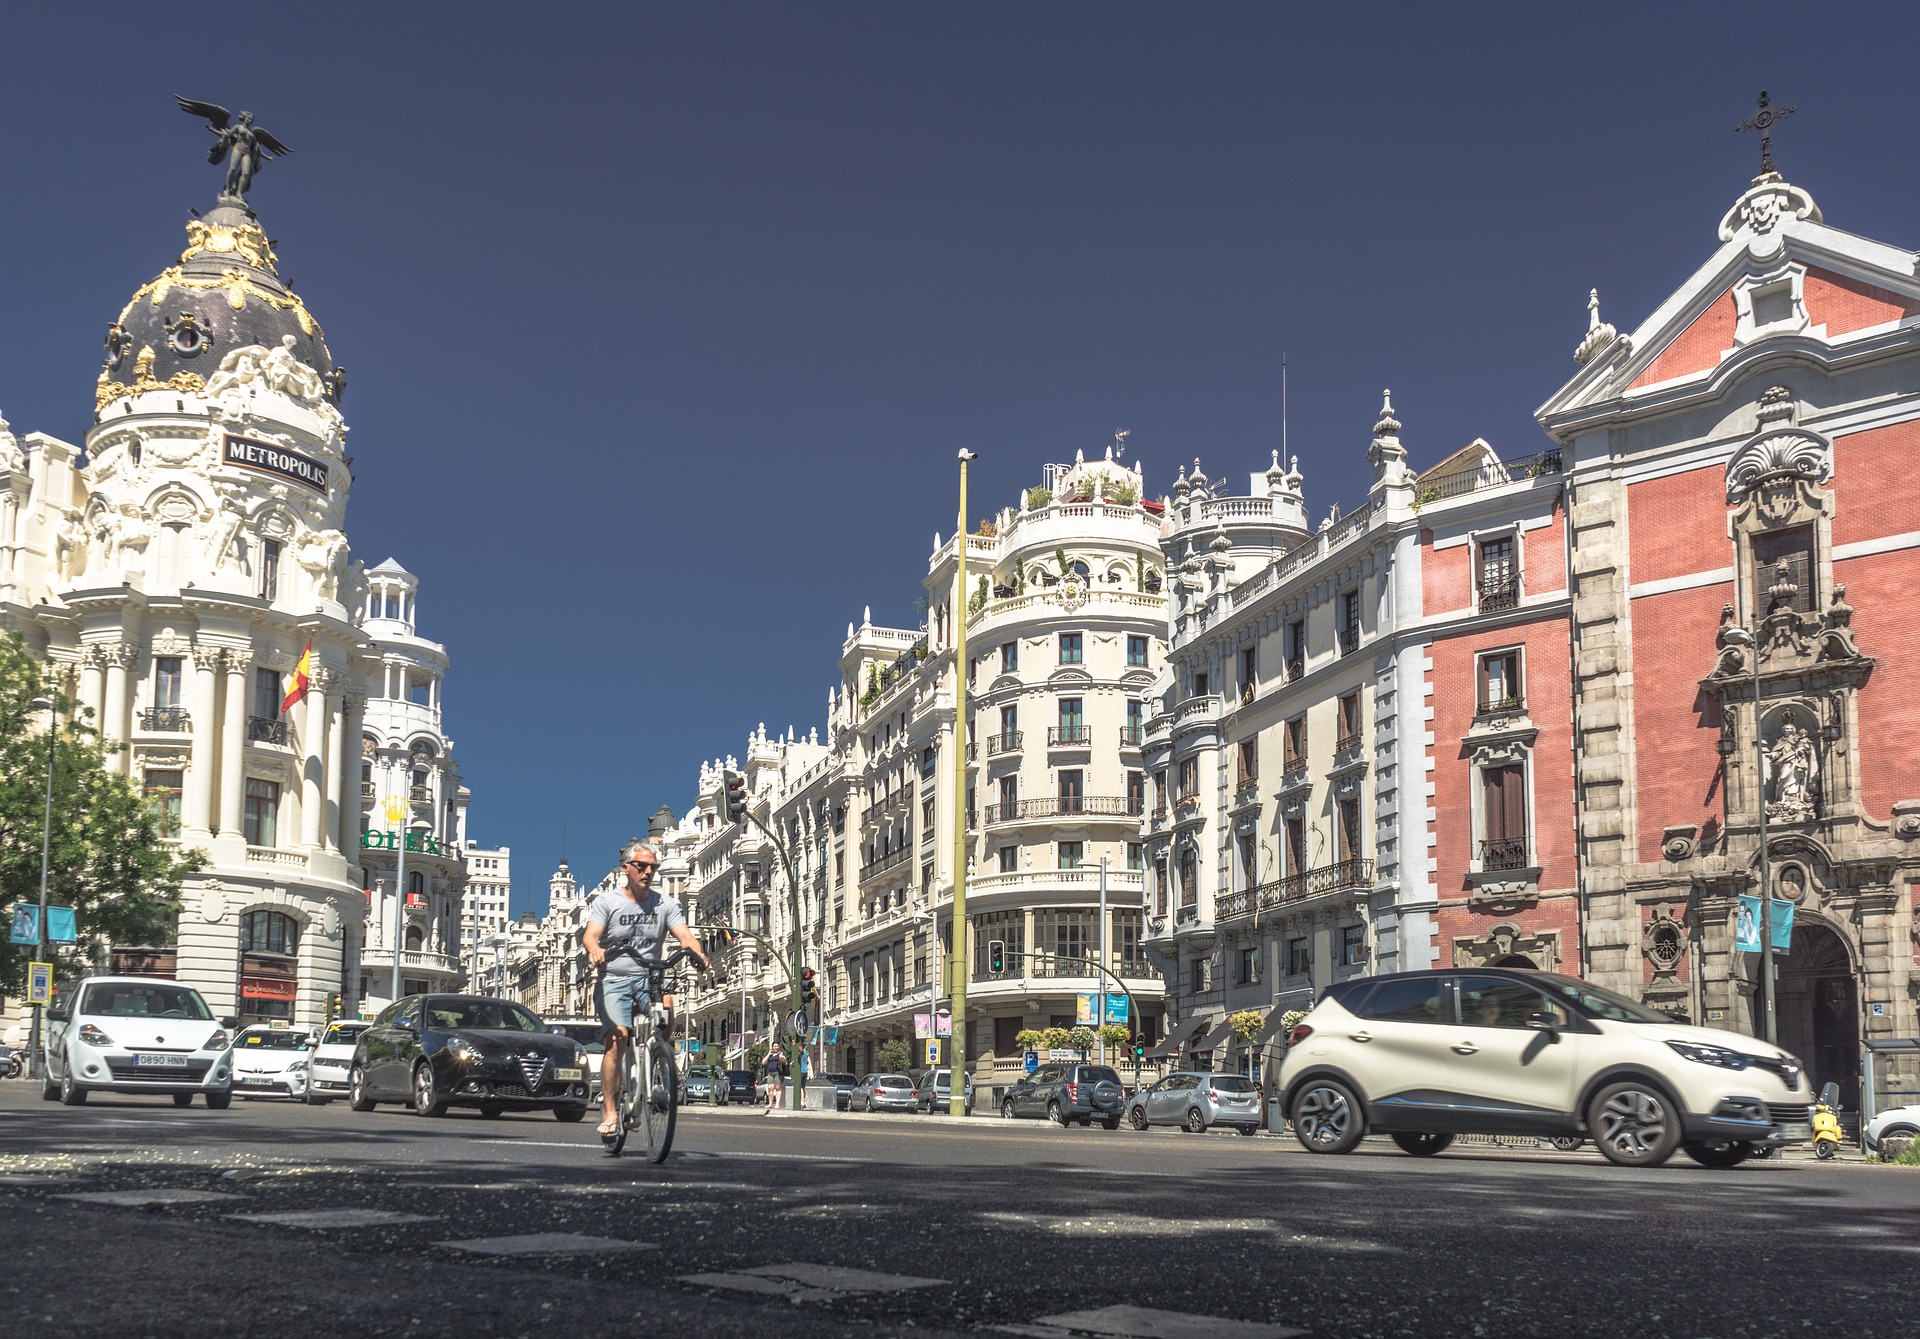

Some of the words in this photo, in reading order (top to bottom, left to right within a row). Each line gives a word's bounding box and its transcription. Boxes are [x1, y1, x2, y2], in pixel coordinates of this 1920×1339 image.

[230, 441, 326, 486] METROPOLIS
[359, 829, 441, 856] OLEX
[619, 913, 658, 925] GREEN
[140, 1056, 165, 1065] 0890
[167, 1057, 186, 1065] HNN
